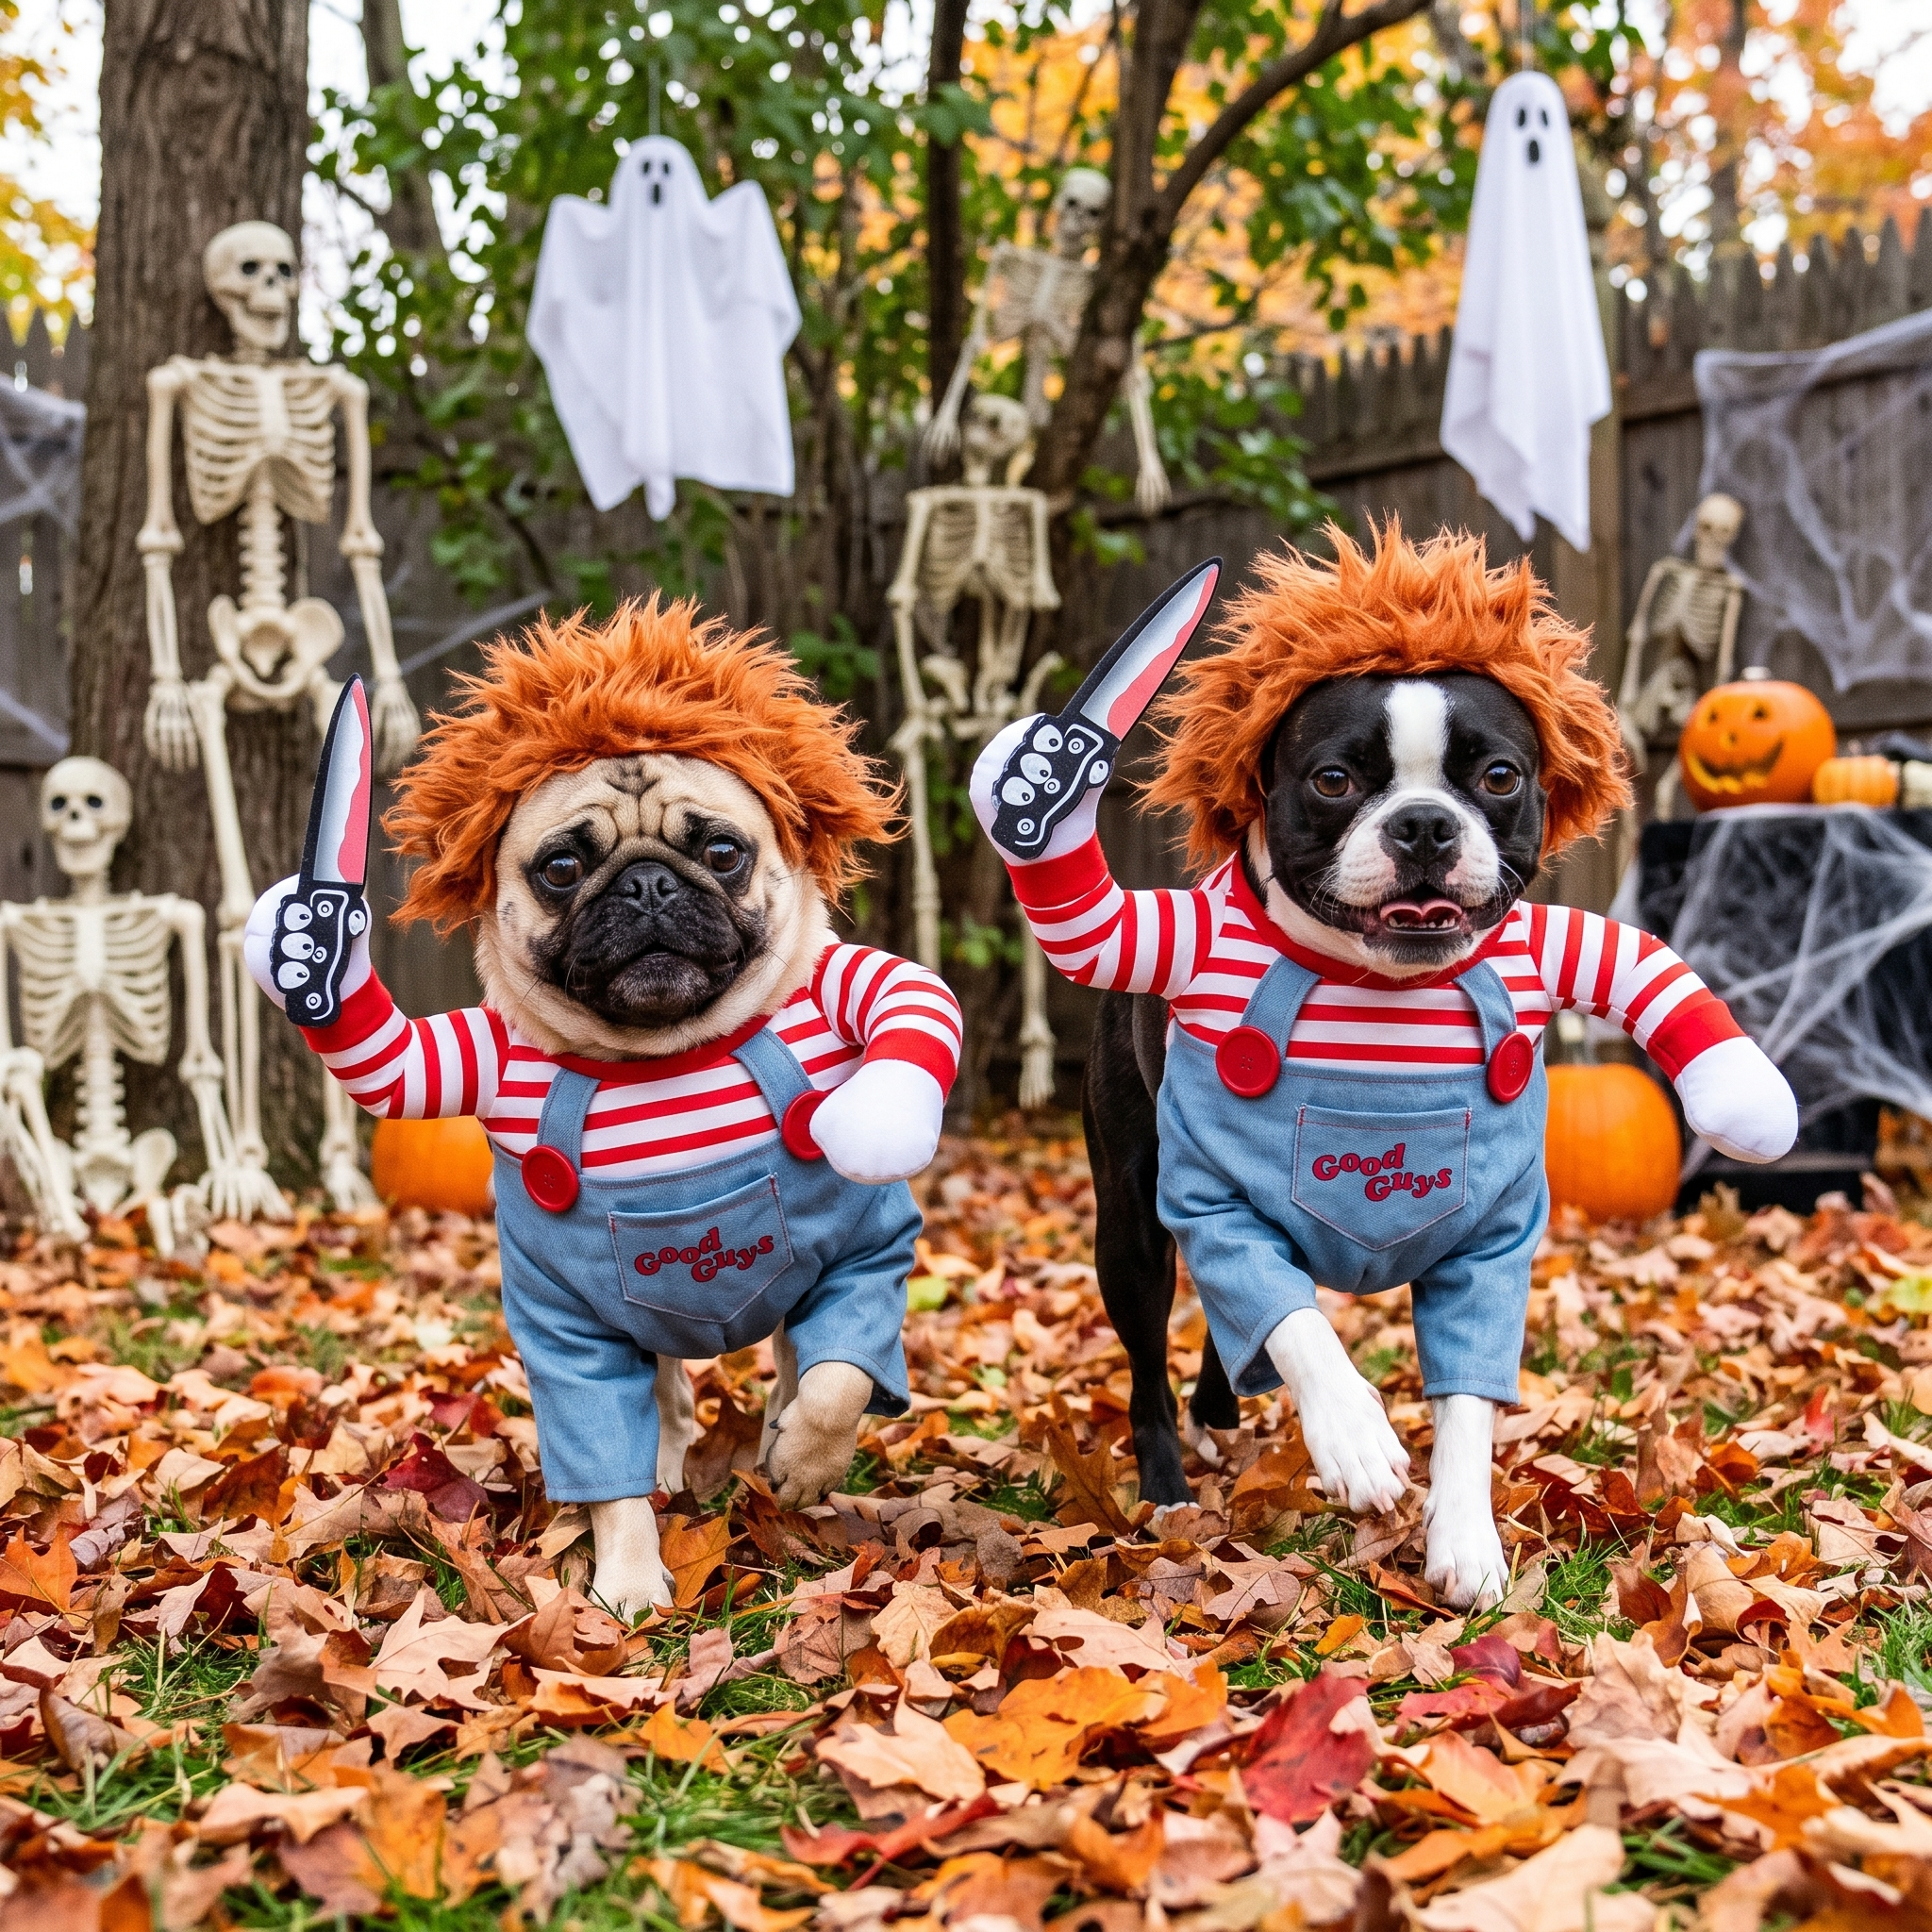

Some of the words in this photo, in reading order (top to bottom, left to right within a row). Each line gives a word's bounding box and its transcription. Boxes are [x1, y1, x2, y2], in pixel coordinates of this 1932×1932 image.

[1312, 1142, 1406, 1182] Good
[1364, 1167, 1453, 1202] Guys
[634, 1226, 722, 1276] Good
[691, 1235, 774, 1283] Guys
